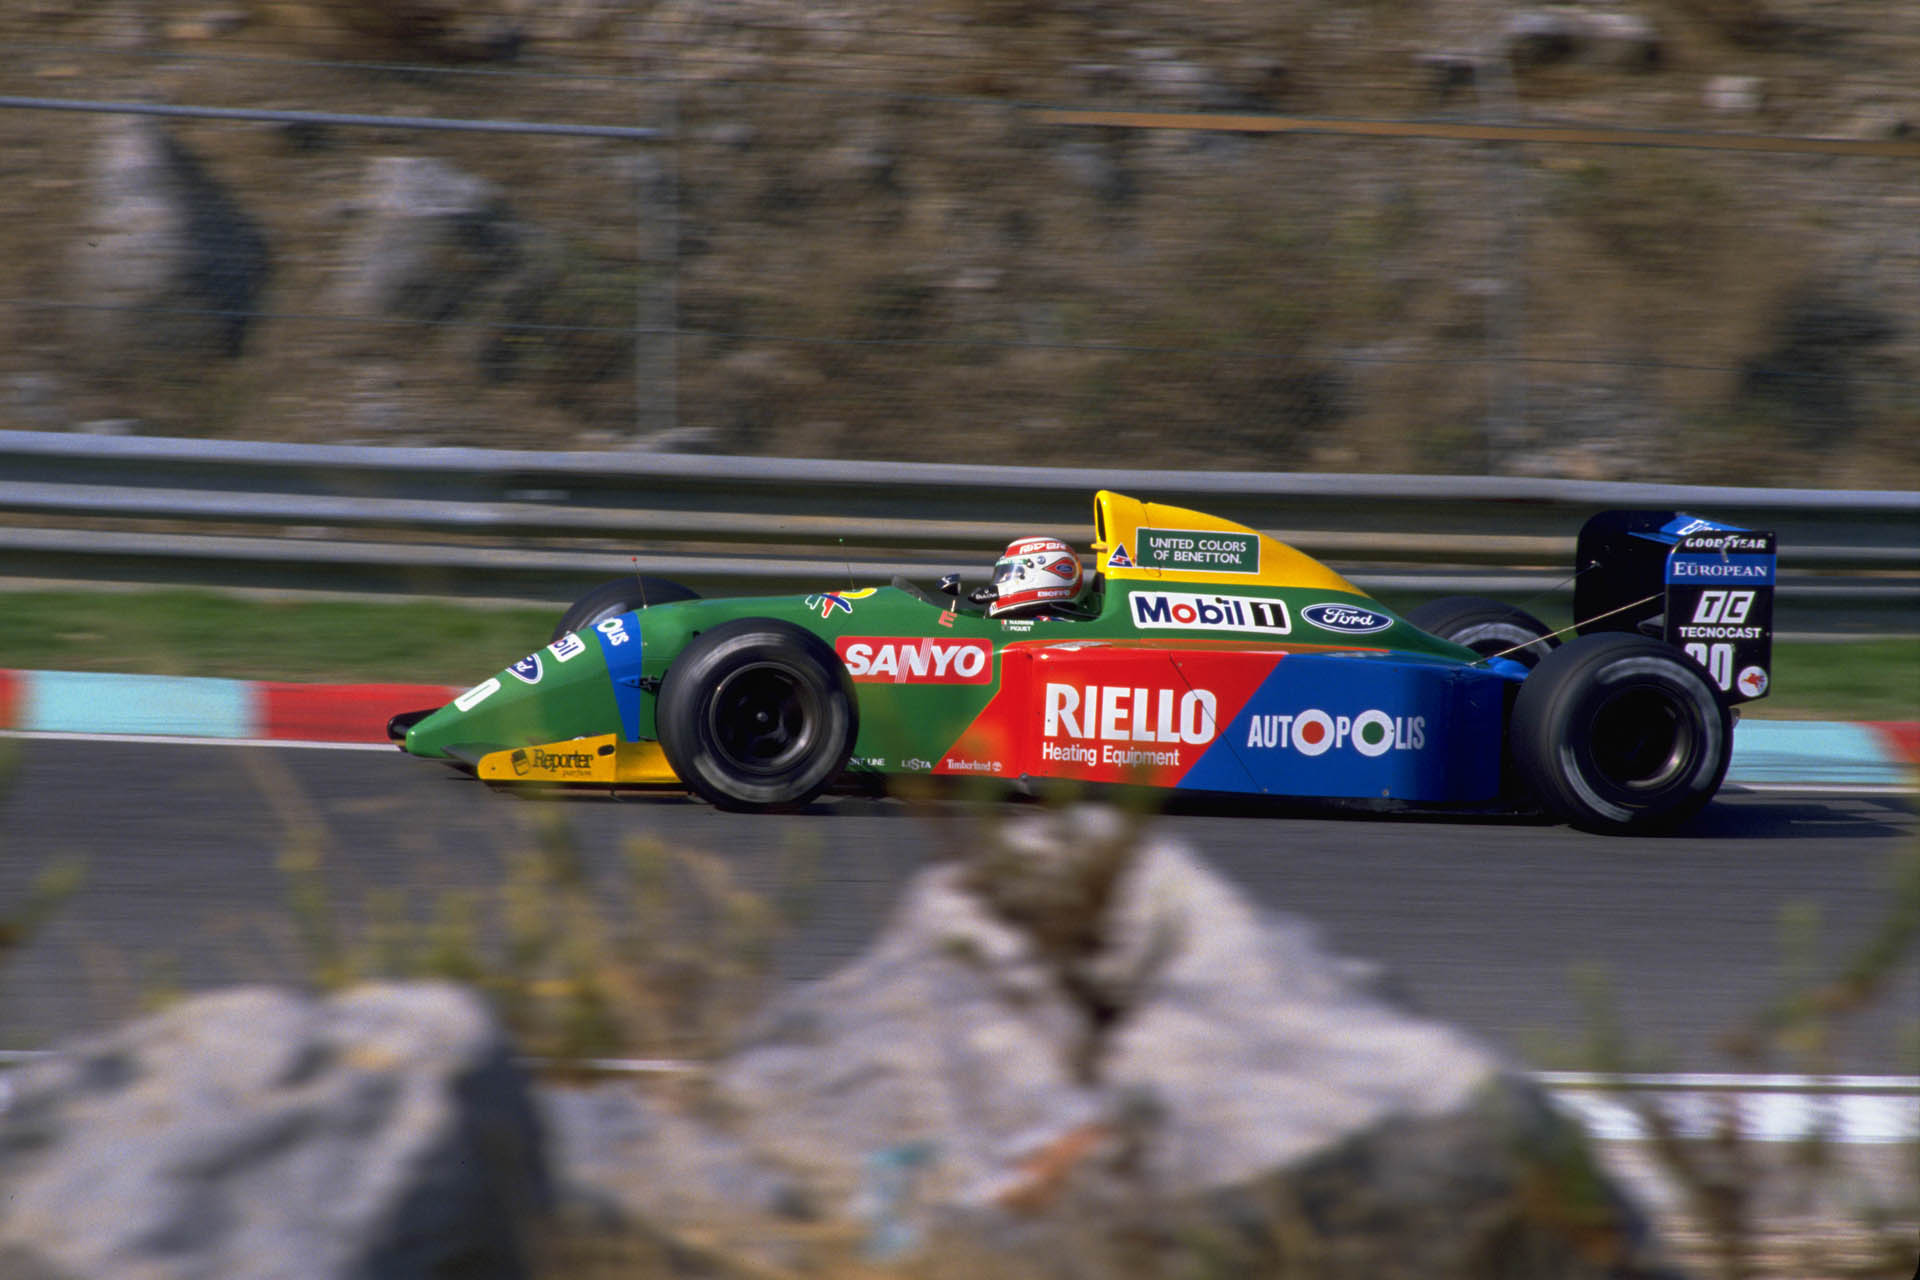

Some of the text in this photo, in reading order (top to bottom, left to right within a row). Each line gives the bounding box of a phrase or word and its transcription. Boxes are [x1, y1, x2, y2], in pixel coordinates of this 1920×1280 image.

[1149, 537, 1247, 552] UNITED COLORS
[1685, 535, 1767, 549] GOODYEAR
[1153, 550, 1242, 564] OF BENETTON.
[1135, 596, 1246, 626] Mobil
[1322, 607, 1375, 626] Ford
[1679, 626, 1762, 638] TECNOCAST
[845, 639, 986, 682] SANYO
[1043, 683, 1217, 745] RIELLO
[1247, 709, 1425, 757] AUTOPOLIS
[532, 748, 593, 772] Reporter
[946, 759, 991, 771] Timberland
[1042, 742, 1180, 767] Heating Equipment
